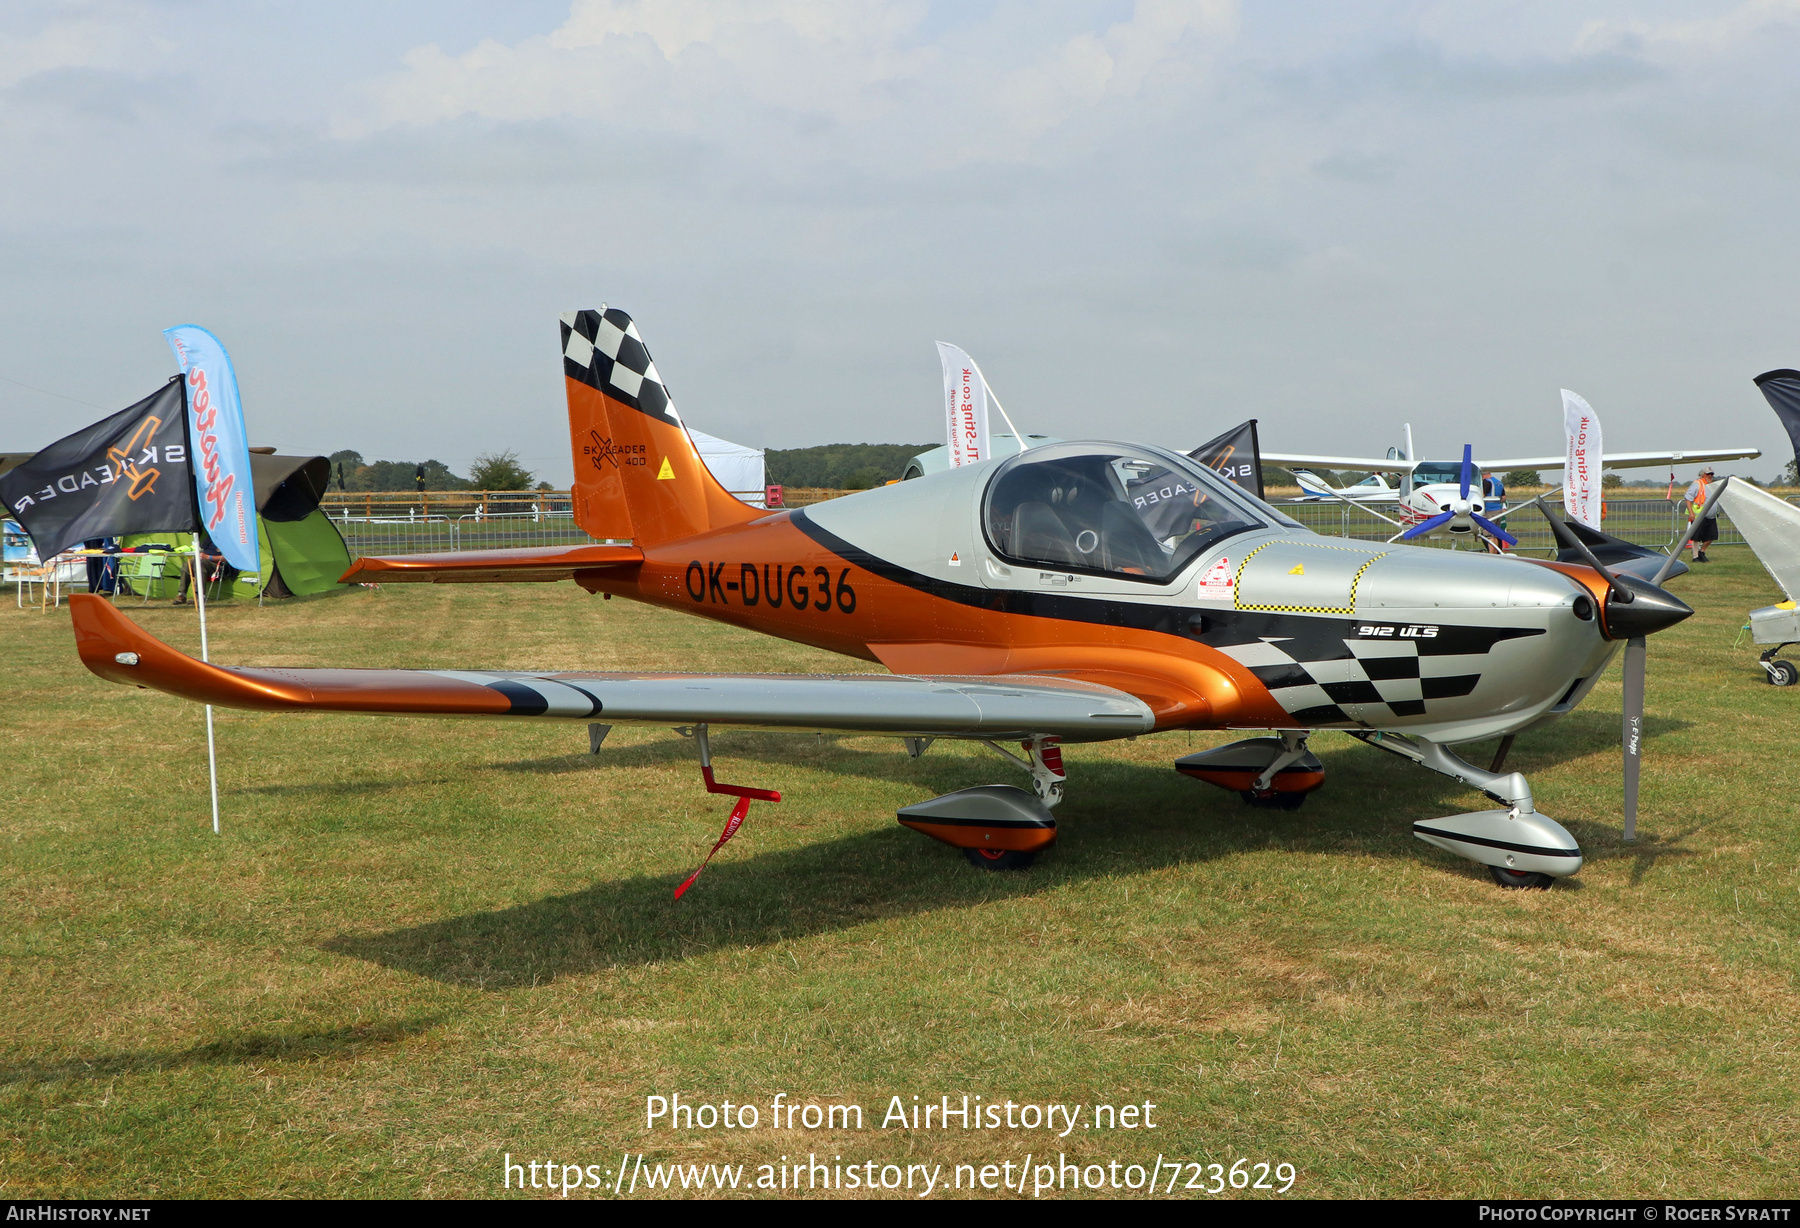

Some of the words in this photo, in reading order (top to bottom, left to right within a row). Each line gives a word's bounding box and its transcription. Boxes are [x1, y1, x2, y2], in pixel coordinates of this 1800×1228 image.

[583, 445, 646, 455] SKYLEADER
[625, 457, 646, 466] 400
[685, 560, 857, 614] OK-DUG36
[1358, 626, 1395, 637] 912
[1399, 627, 1439, 638] ULS
